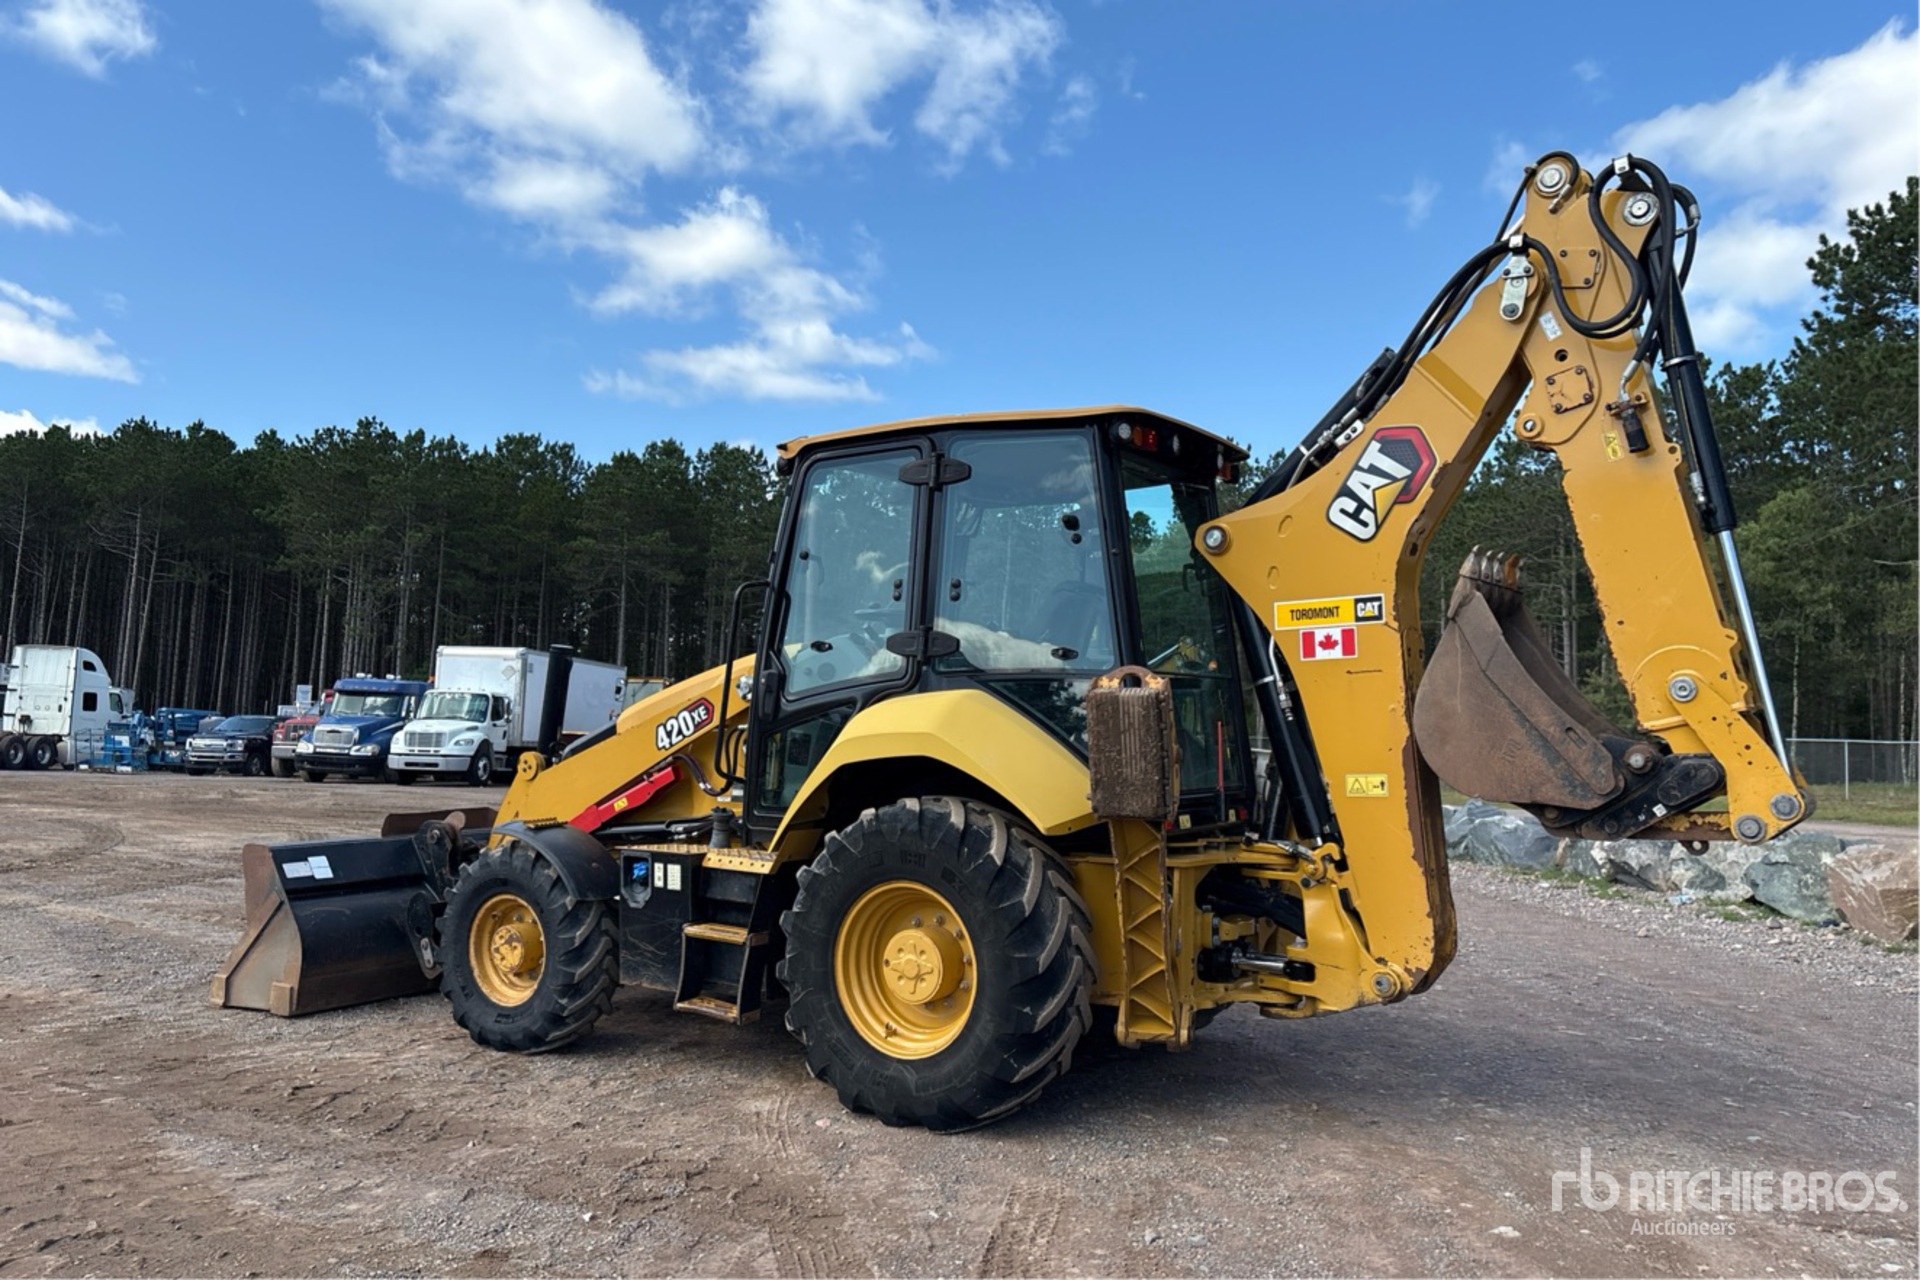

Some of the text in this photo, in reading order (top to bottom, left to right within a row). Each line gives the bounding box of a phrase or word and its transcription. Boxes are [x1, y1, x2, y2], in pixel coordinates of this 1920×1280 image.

[1328, 440, 1412, 541] CAT
[1290, 601, 1381, 621] TOROMONT CAT
